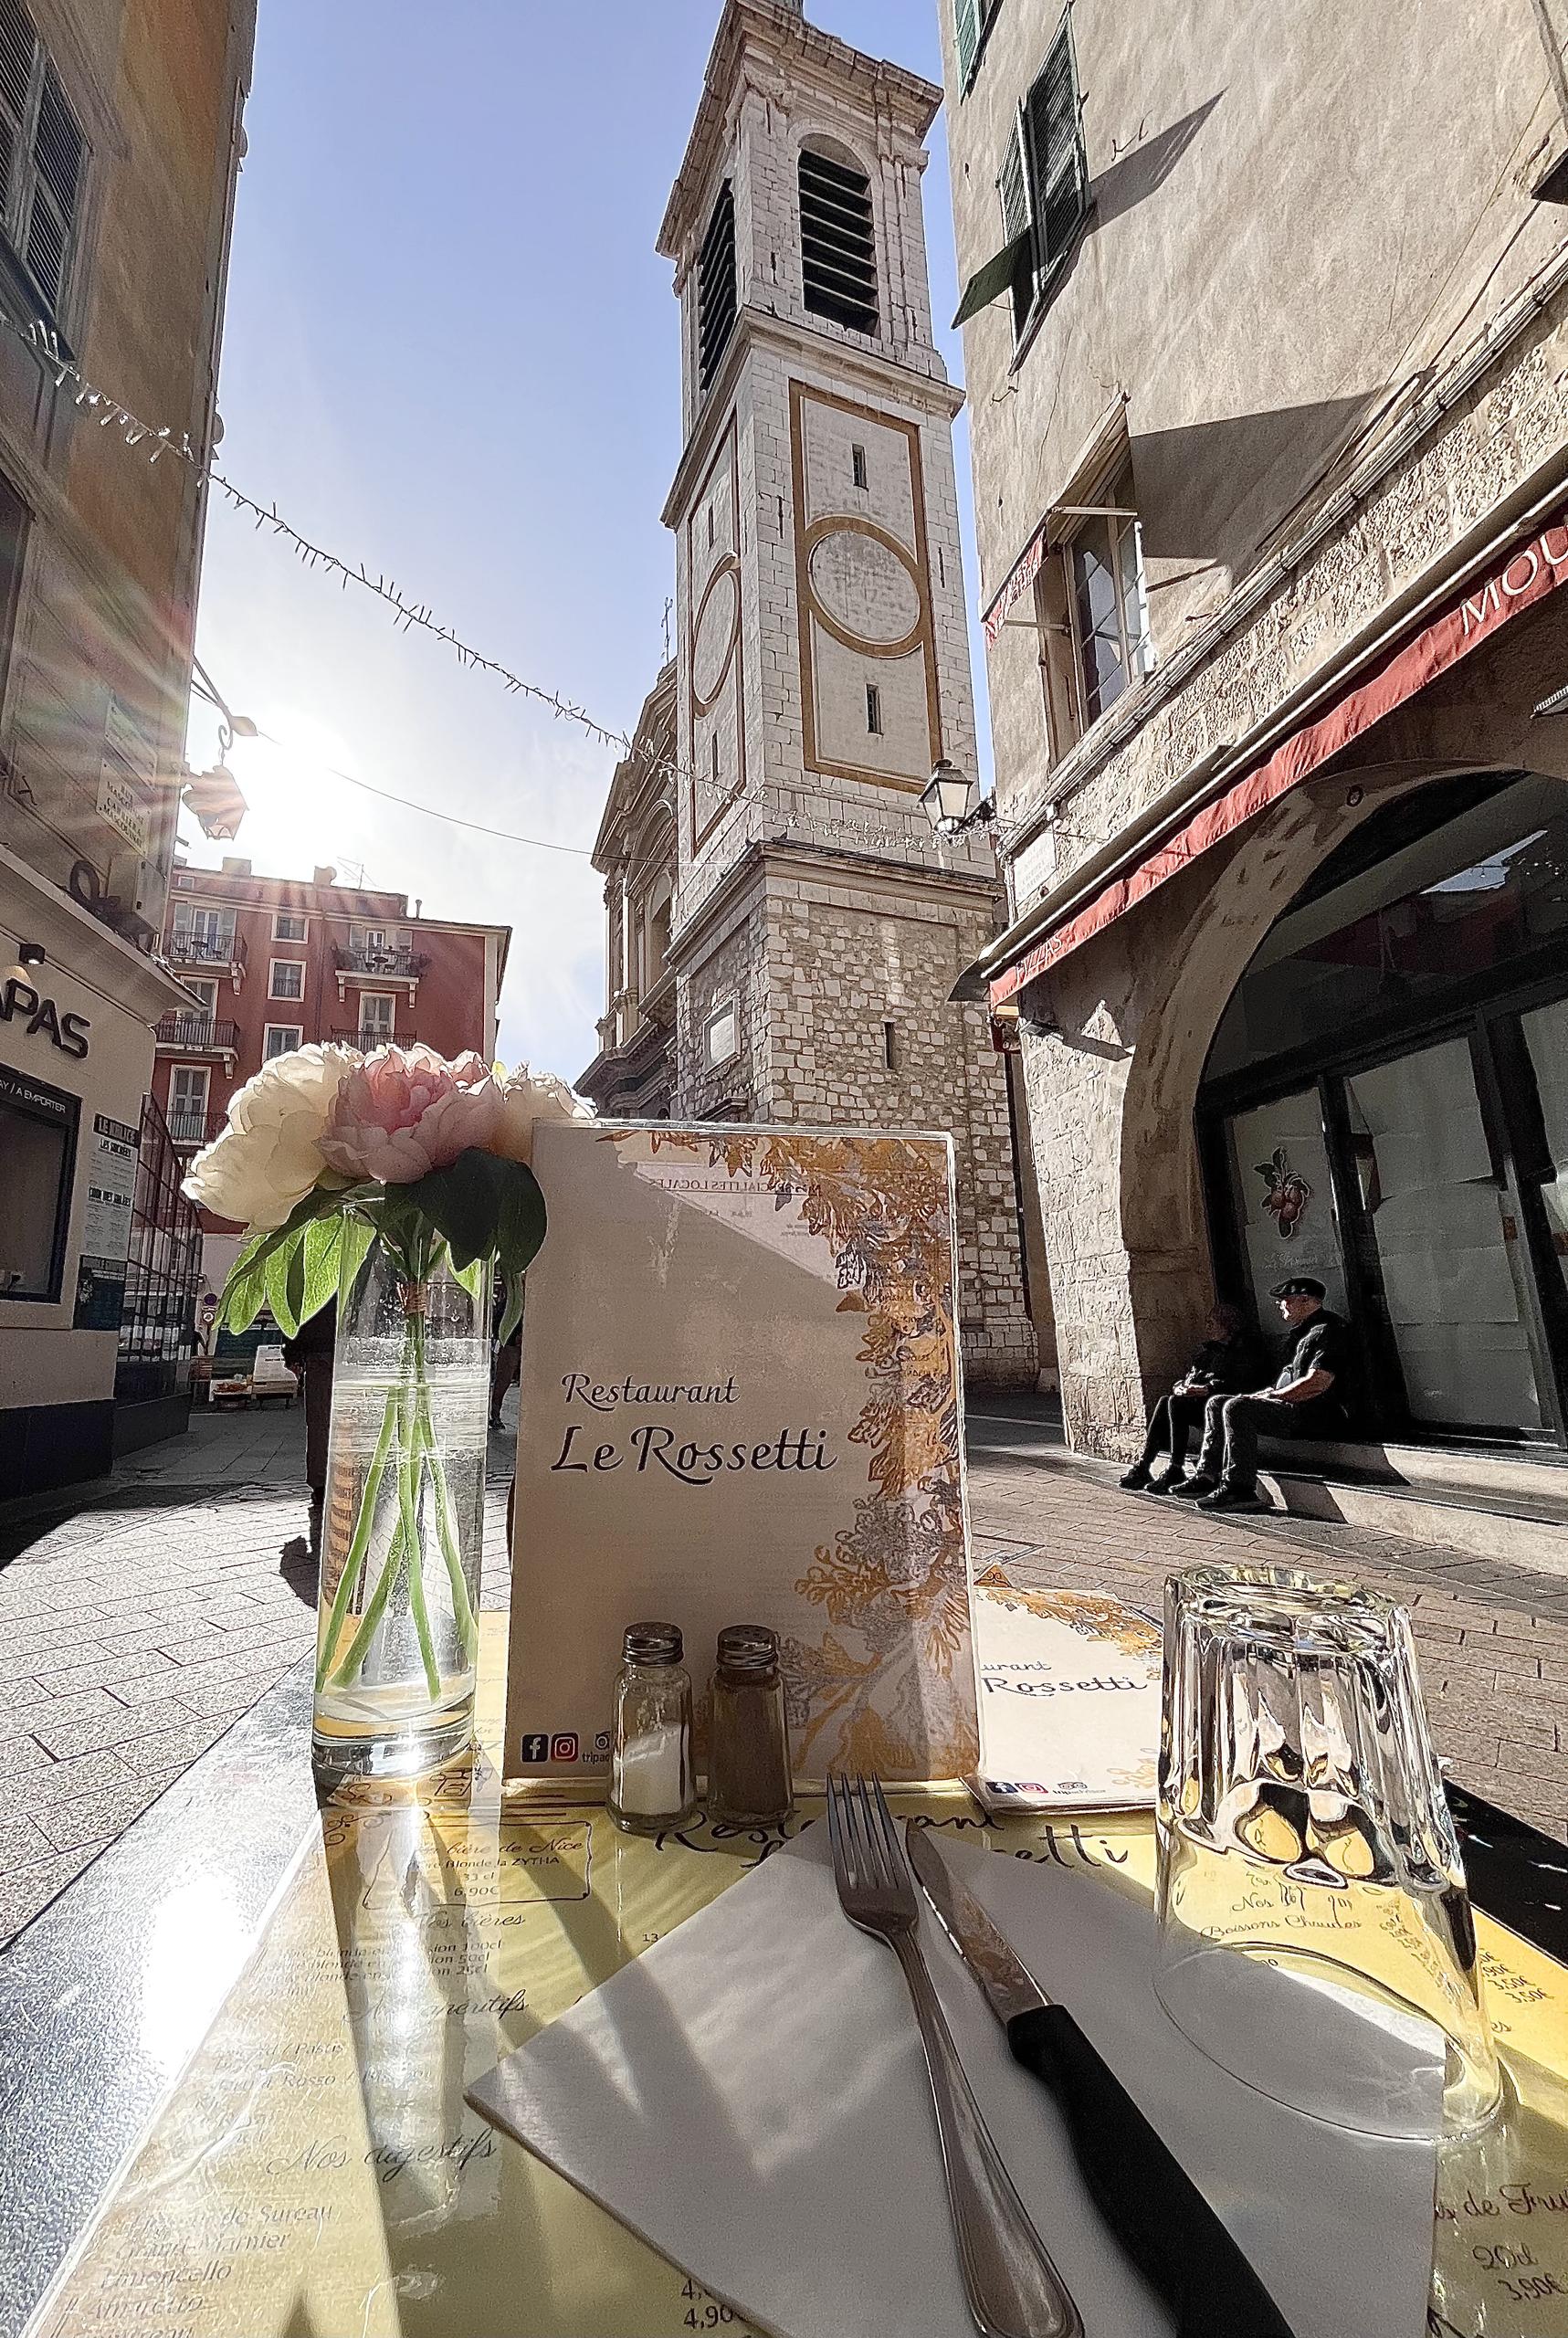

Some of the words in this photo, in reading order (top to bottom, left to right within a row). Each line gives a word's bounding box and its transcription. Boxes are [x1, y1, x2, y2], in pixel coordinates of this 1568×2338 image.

[24, 1090, 66, 1113] EMPORTER
[561, 1373, 741, 1412] Restaurant
[550, 1425, 625, 1473] Le
[630, 1425, 838, 1486] Rossetti
[980, 1660, 1052, 1672] urant
[981, 1677, 1148, 1697] Rossetti
[499, 1841, 523, 1853] de
[529, 1837, 585, 1853] Nice
[511, 1856, 560, 1867] ZYTHA
[1504, 1988, 1555, 2004] 3,50€
[1463, 2189, 1500, 2217] de
[683, 2304, 734, 2330] 4,90
